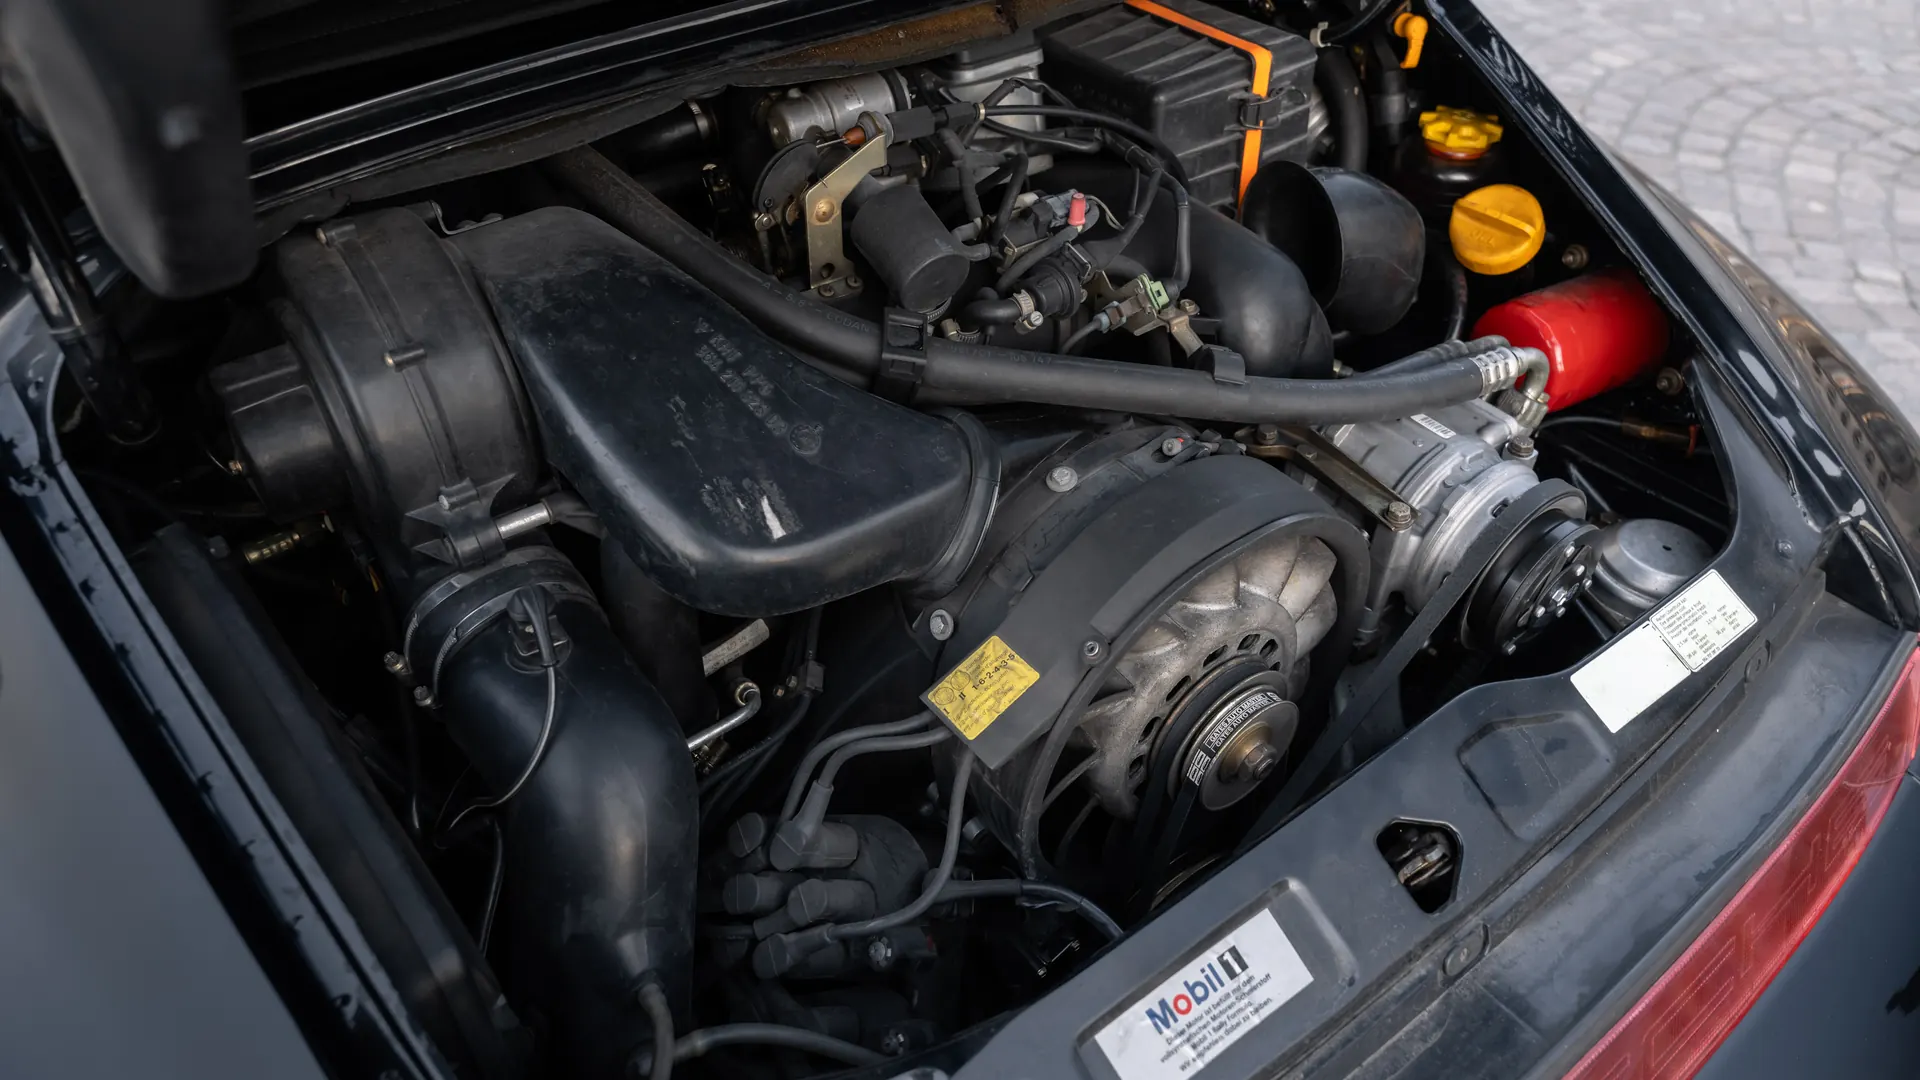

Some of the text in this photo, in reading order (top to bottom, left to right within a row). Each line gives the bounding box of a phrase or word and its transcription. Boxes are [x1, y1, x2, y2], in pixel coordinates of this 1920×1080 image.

[826, 311, 870, 333] CODAN
[970, 651, 1016, 691] 1-6-2-4-3-5
[1209, 720, 1227, 742] GATES
[1225, 705, 1243, 724] AUTO
[1239, 693, 1264, 710] MASTER
[1214, 698, 1271, 747] GATES AUTO MASTER
[1144, 946, 1247, 1035] Mobil 1
[1184, 1011, 1205, 1030] Motor
[1240, 973, 1255, 988] dem
